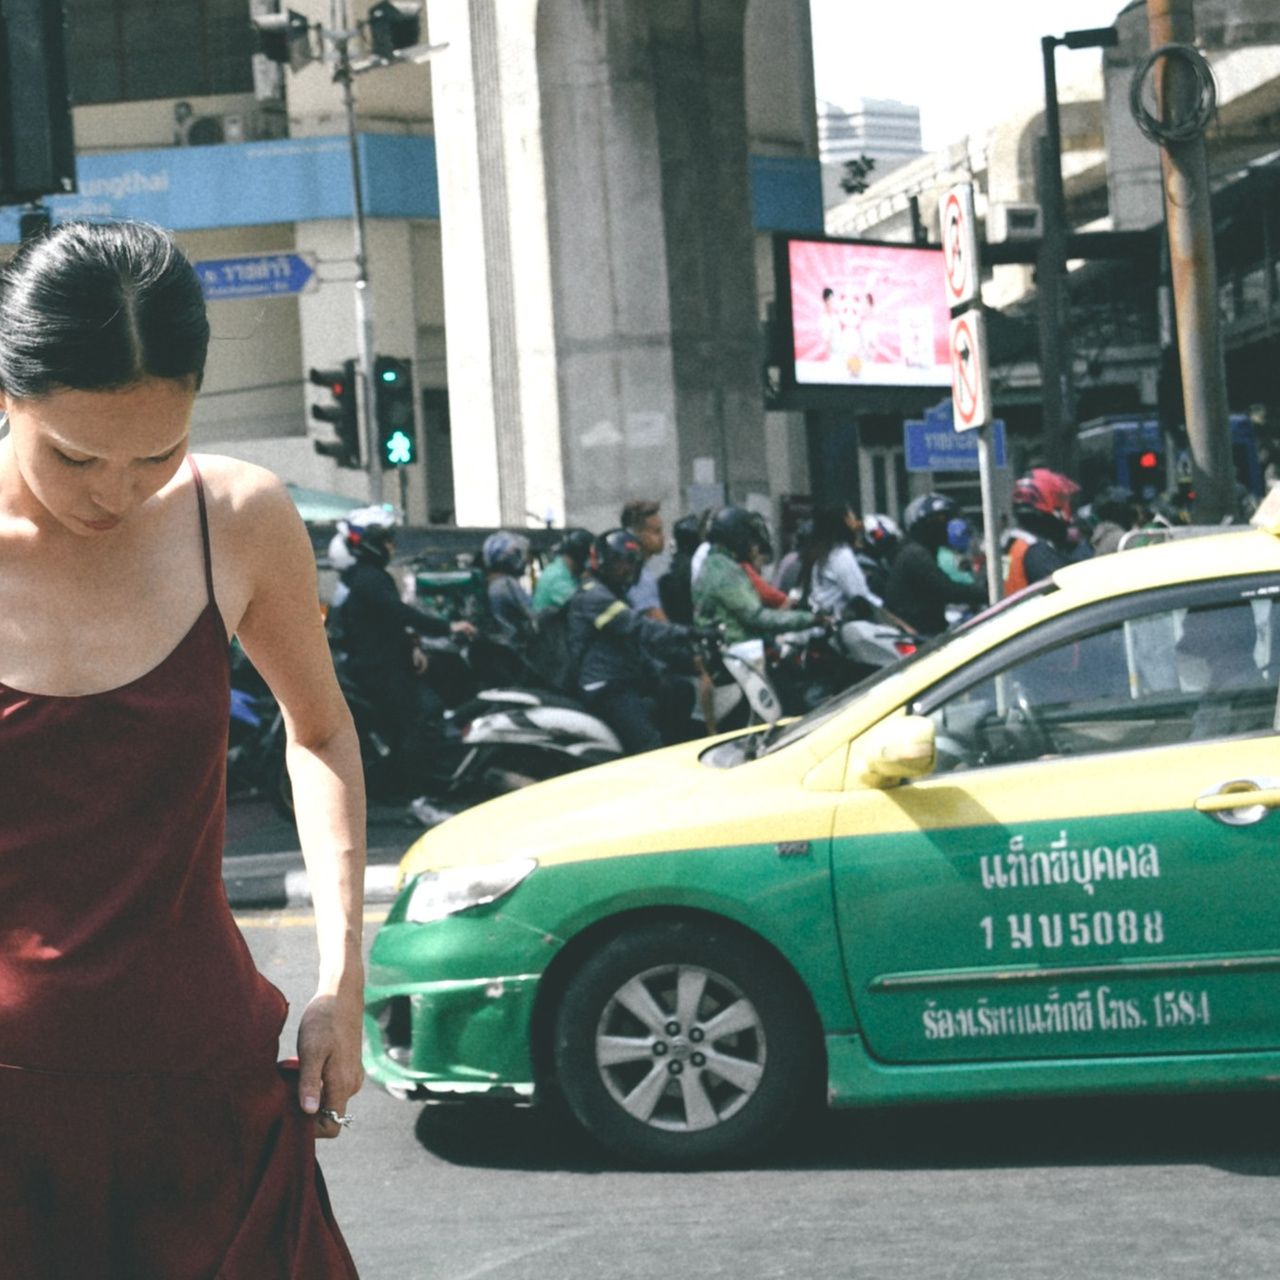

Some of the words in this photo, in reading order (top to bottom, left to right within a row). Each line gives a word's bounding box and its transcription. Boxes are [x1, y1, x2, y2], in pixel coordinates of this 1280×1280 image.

[78, 168, 169, 201] ungthai
[979, 829, 1160, 896] แท็กซี่บุคคล
[1152, 990, 1211, 1028] 1584
